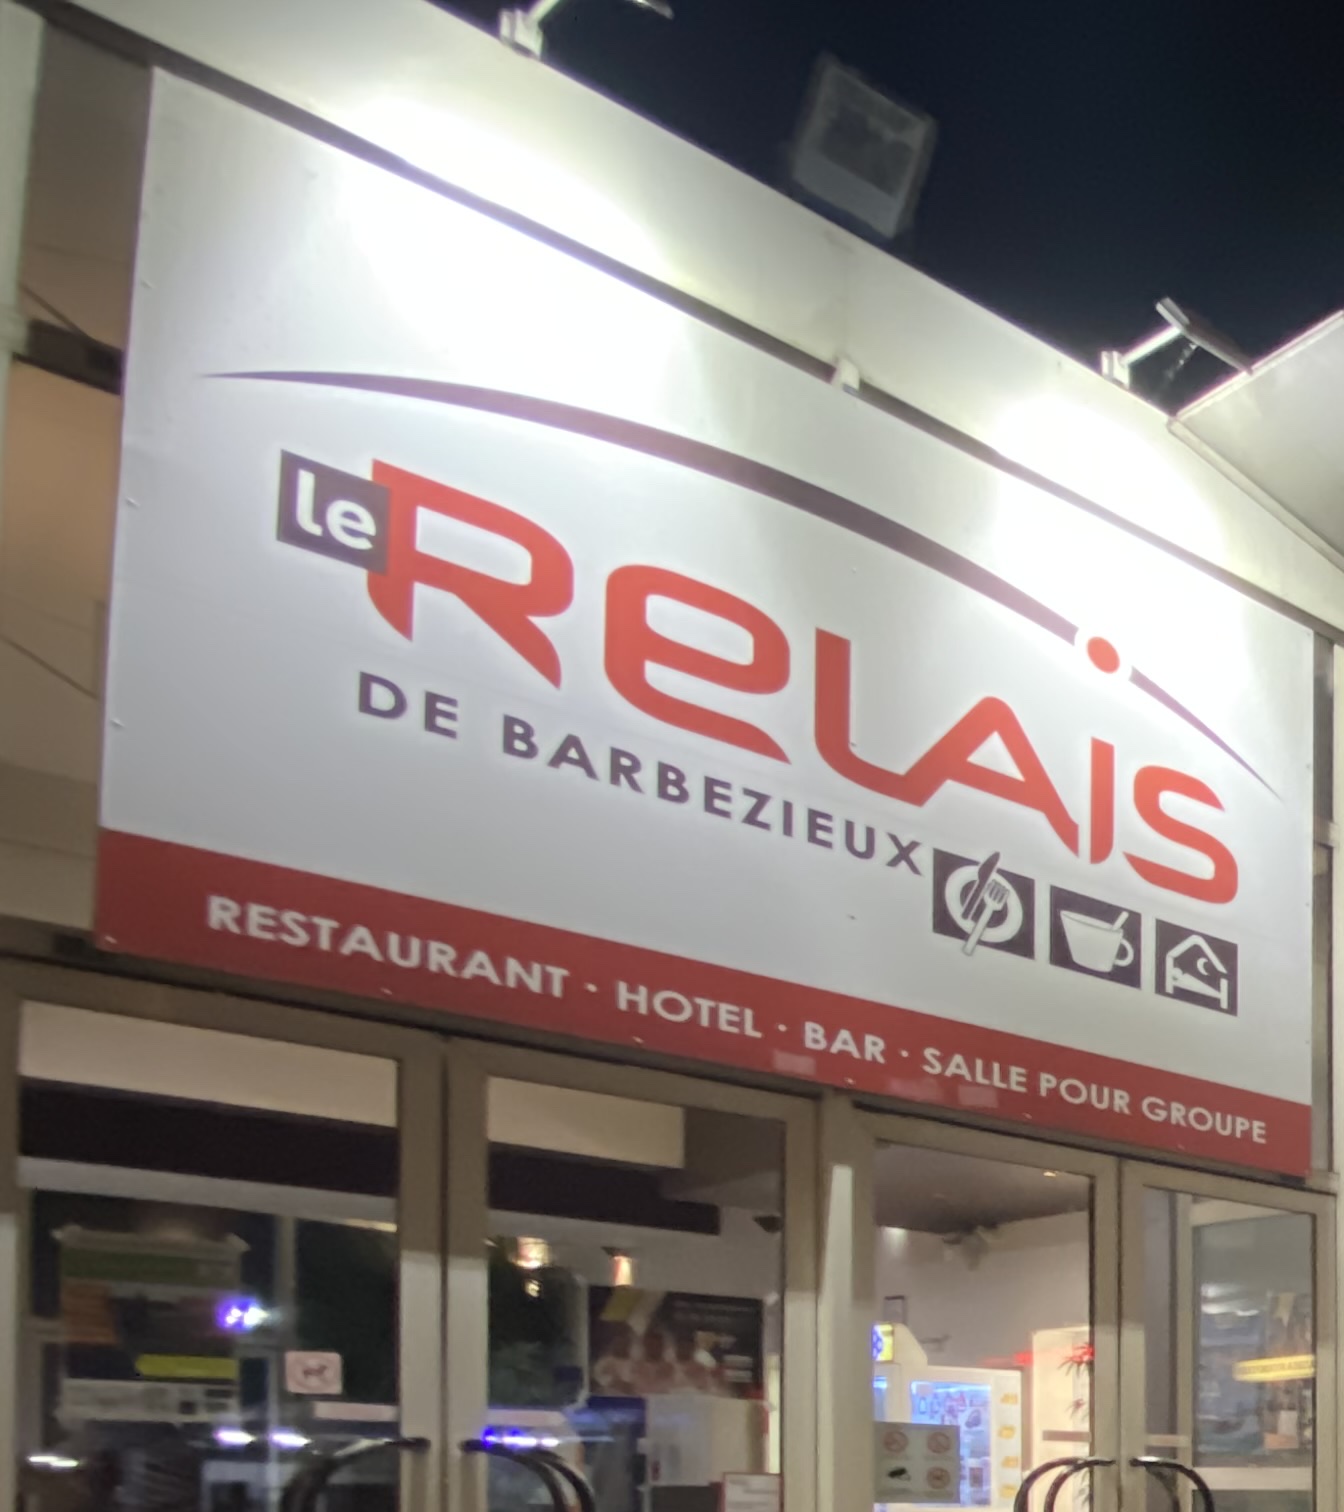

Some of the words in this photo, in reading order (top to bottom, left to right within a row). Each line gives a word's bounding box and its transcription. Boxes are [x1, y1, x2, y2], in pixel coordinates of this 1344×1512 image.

[294, 467, 379, 551] le
[357, 670, 460, 740] DE
[502, 712, 923, 877] BARBEZIEUX
[208, 895, 569, 999] RESTAURANT
[617, 980, 763, 1039] HOTEL
[803, 1020, 887, 1065] BAR
[922, 1046, 1027, 1093] SALLE
[1038, 1072, 1131, 1115] POUR
[1141, 1096, 1267, 1145] GROUPE
